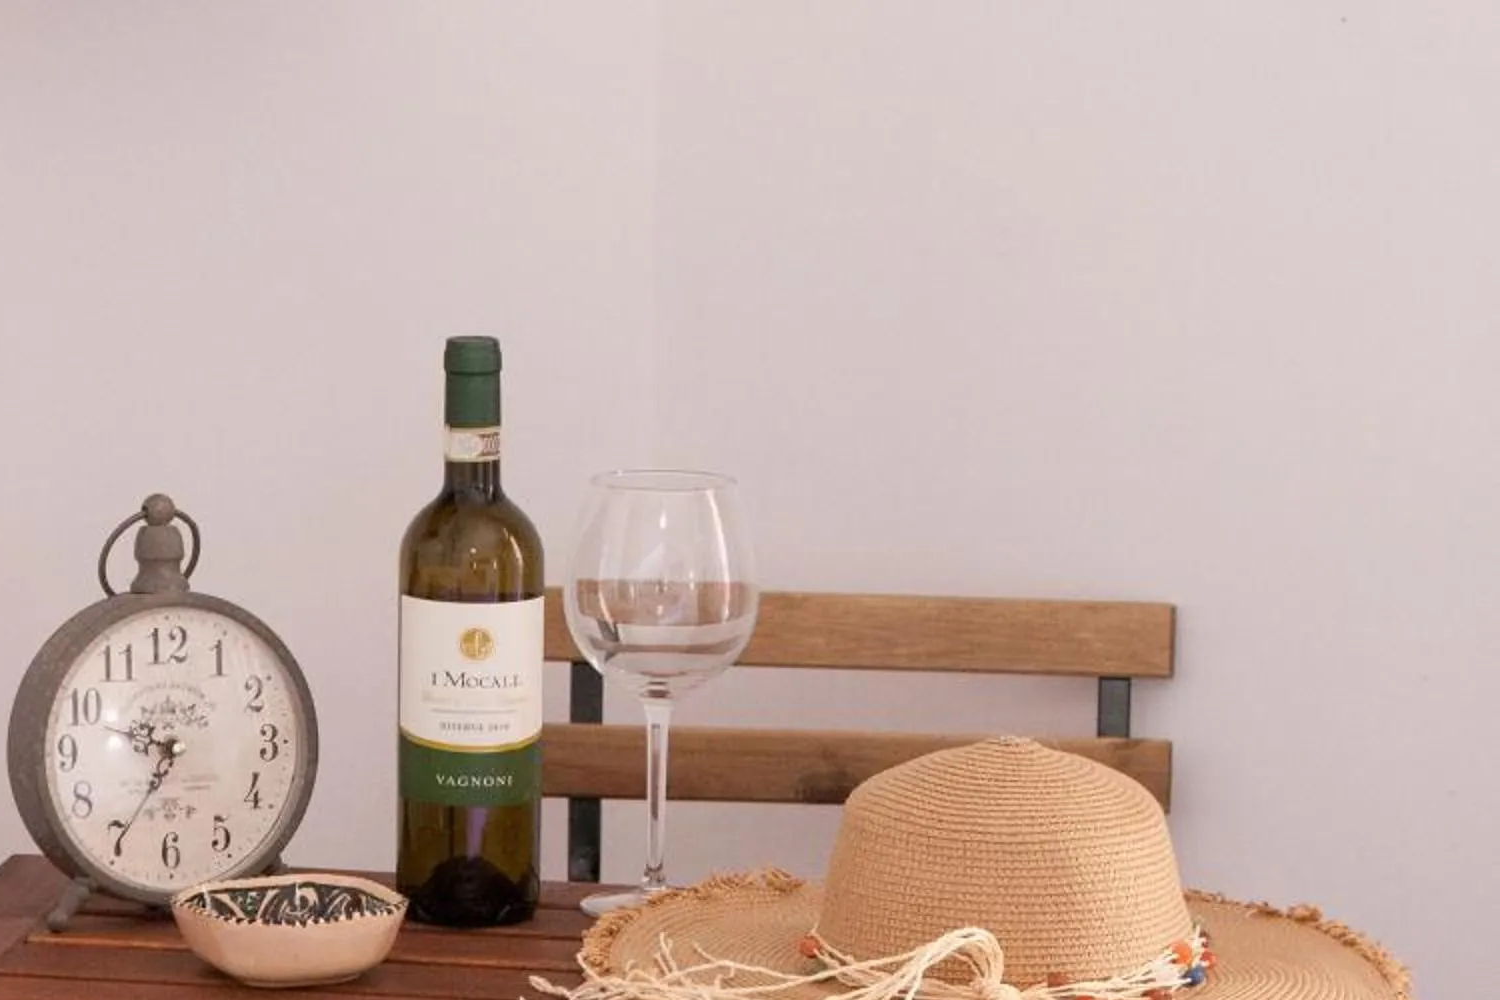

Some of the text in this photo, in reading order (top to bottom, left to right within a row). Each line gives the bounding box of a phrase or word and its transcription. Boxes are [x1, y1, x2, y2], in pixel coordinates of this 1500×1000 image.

[100, 643, 134, 682] 11
[147, 626, 188, 665] 12
[208, 639, 228, 677] 1
[68, 687, 102, 727] 10
[244, 675, 264, 713] 2
[58, 734, 78, 772] 9
[259, 723, 279, 762] 3
[244, 772, 262, 809] 4
[436, 773, 514, 787] VAGNONI
[72, 780, 93, 819] 8
[107, 819, 129, 857] 7
[161, 831, 181, 870] 6
[211, 815, 231, 852] 5
